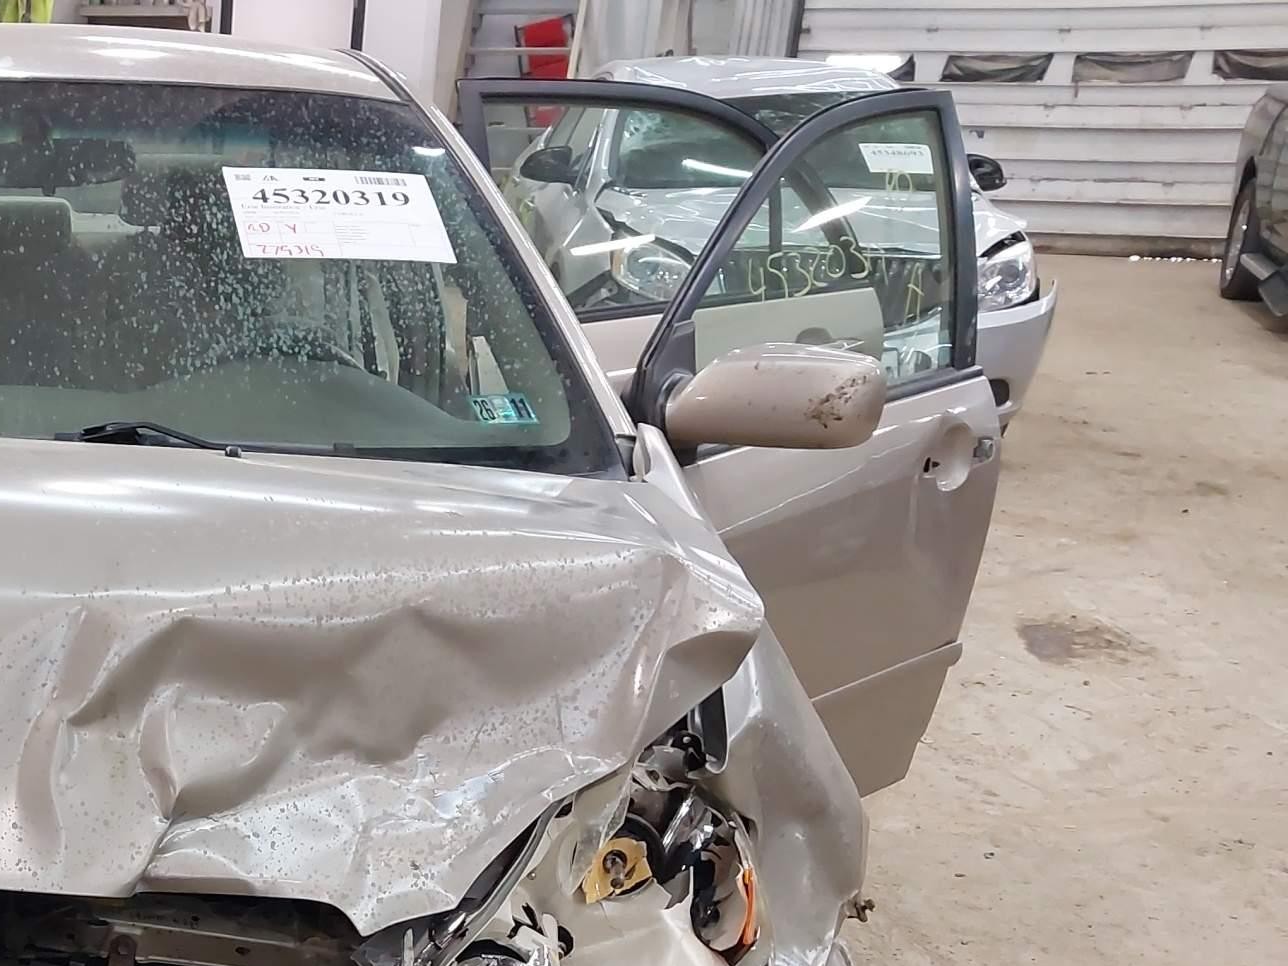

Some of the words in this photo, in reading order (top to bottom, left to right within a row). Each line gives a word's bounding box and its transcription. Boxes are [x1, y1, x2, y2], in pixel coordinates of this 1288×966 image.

[252, 187, 410, 207] 45320319
[472, 399, 497, 421] 26
[510, 397, 534, 420] 11
